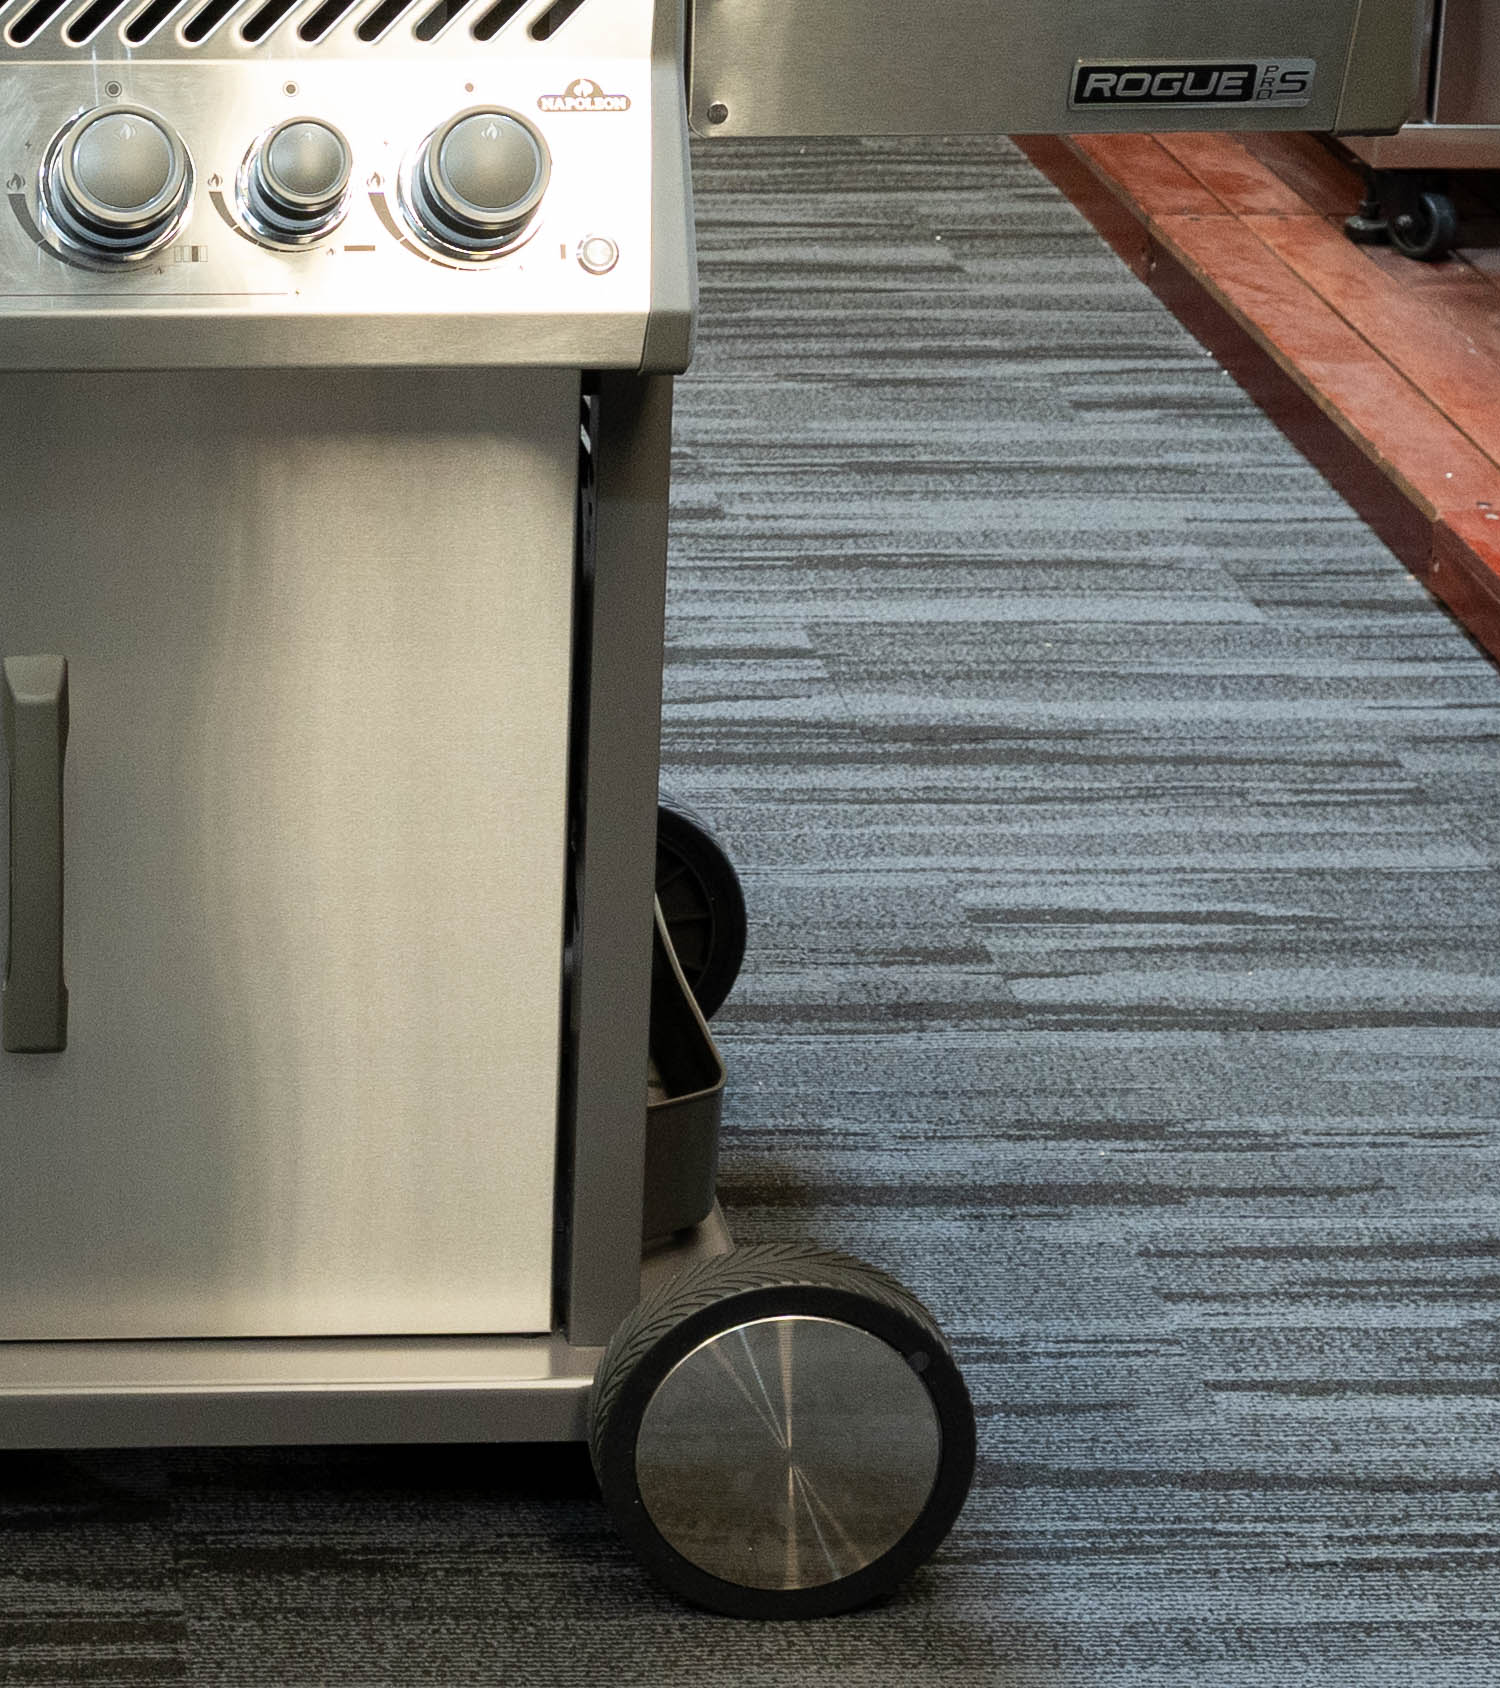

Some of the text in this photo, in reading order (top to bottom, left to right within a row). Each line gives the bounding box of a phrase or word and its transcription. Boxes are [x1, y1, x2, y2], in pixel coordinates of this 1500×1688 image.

[1082, 64, 1311, 100] ROGUE PRO S
[540, 96, 627, 110] NAPOLEON
